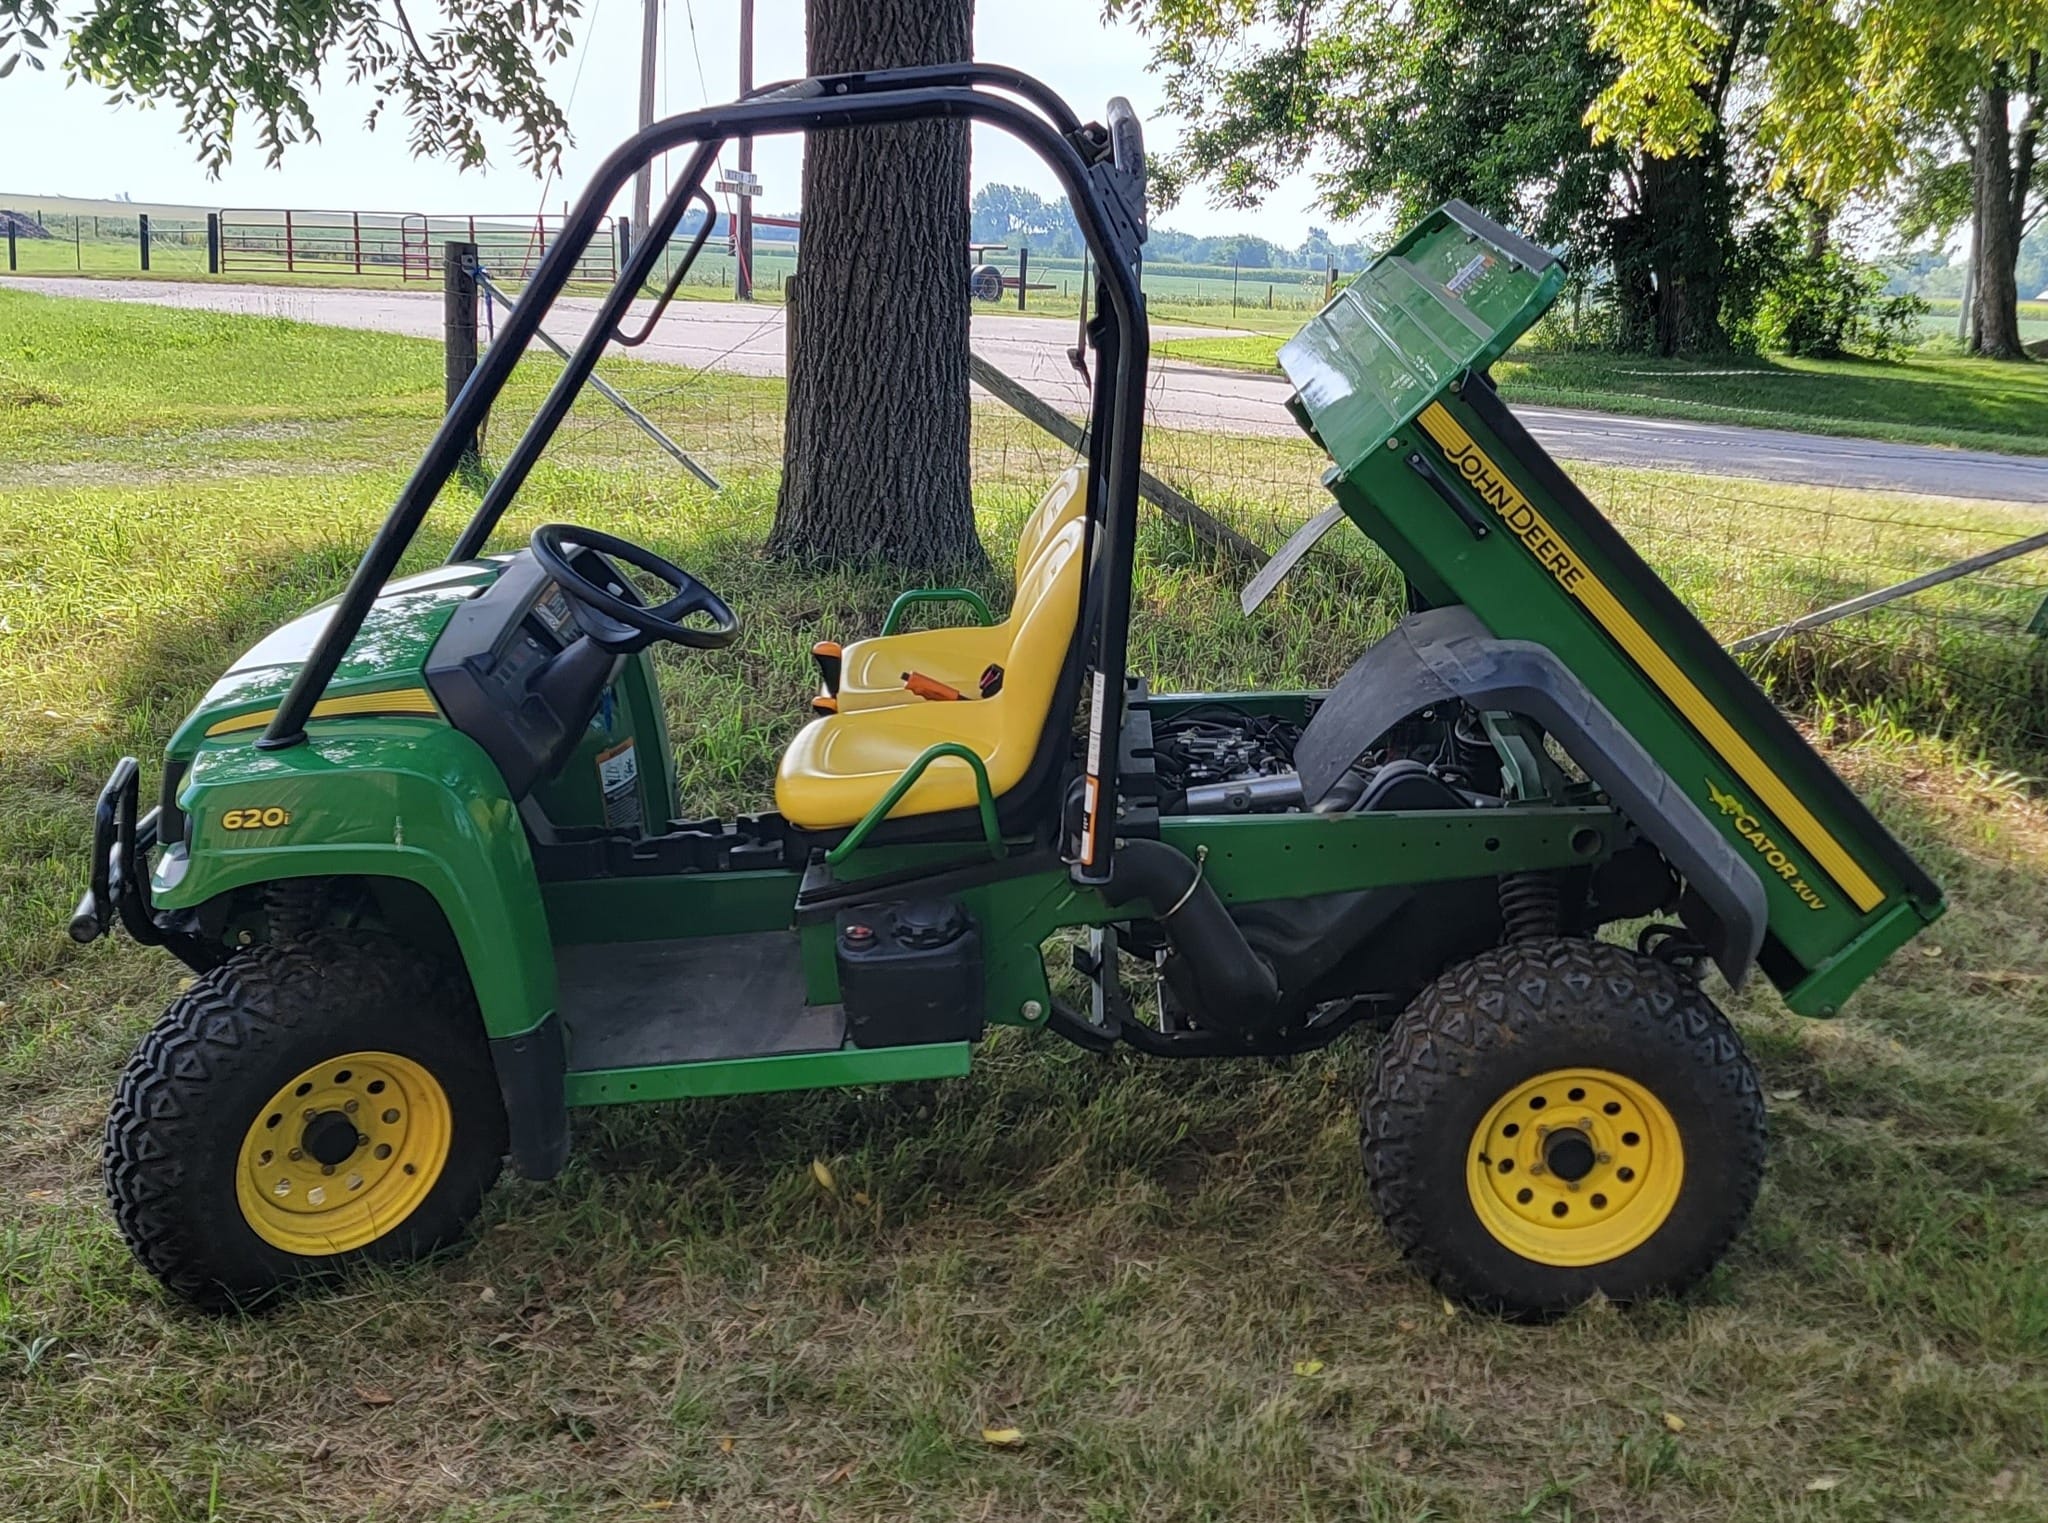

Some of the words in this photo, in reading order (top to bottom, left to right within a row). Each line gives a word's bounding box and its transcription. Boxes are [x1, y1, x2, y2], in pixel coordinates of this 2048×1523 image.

[1445, 443, 1514, 511] JOHN
[1507, 503, 1586, 590] DEERE
[222, 806, 291, 831] 620i
[1734, 814, 1799, 880] GATOR
[1790, 879, 1828, 911] XUV
